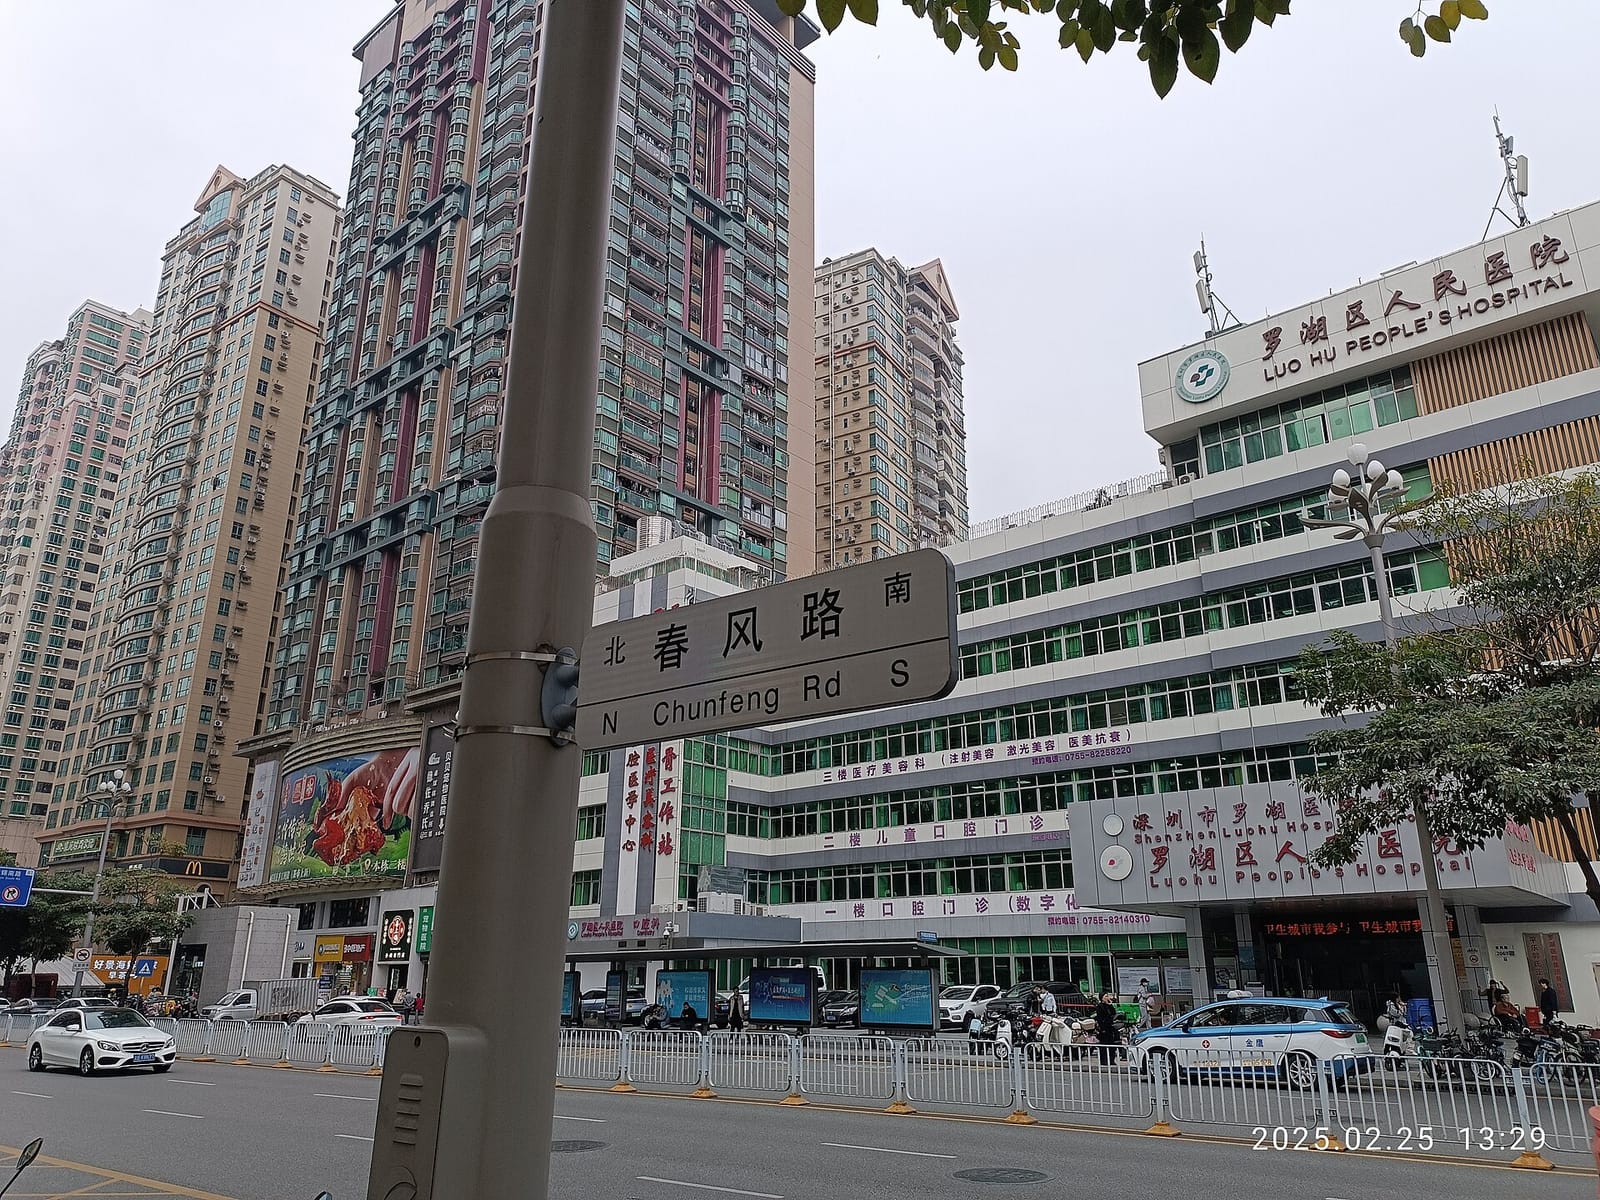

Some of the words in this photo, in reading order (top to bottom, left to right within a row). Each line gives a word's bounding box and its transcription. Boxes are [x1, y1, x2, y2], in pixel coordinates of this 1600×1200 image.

[1262, 234, 1570, 361] 罗湖区人民医院
[1264, 359, 1300, 382] LUO
[1310, 346, 1336, 367] HU
[1345, 310, 1452, 356] PEOPLE'S
[1458, 272, 1573, 319] HOSPITAL
[603, 635, 626, 666] 北
[653, 587, 844, 672] 春风路
[883, 571, 912, 607] 南
[602, 711, 618, 735] N
[653, 687, 779, 726] Chunfeng
[803, 670, 840, 701] Rd
[890, 659, 910, 687] S
[823, 757, 925, 782] 三楼医疗美容科
[1007, 740, 1056, 757] 激光美容
[824, 814, 1044, 848] 二楼儿童口腔门诊
[1134, 830, 1216, 845] Shenzhen
[1222, 824, 1278, 838] Luohu
[1150, 829, 1463, 874] 罗湖区人医
[1150, 874, 1217, 888] Luohu
[1356, 857, 1471, 877] Hosptal
